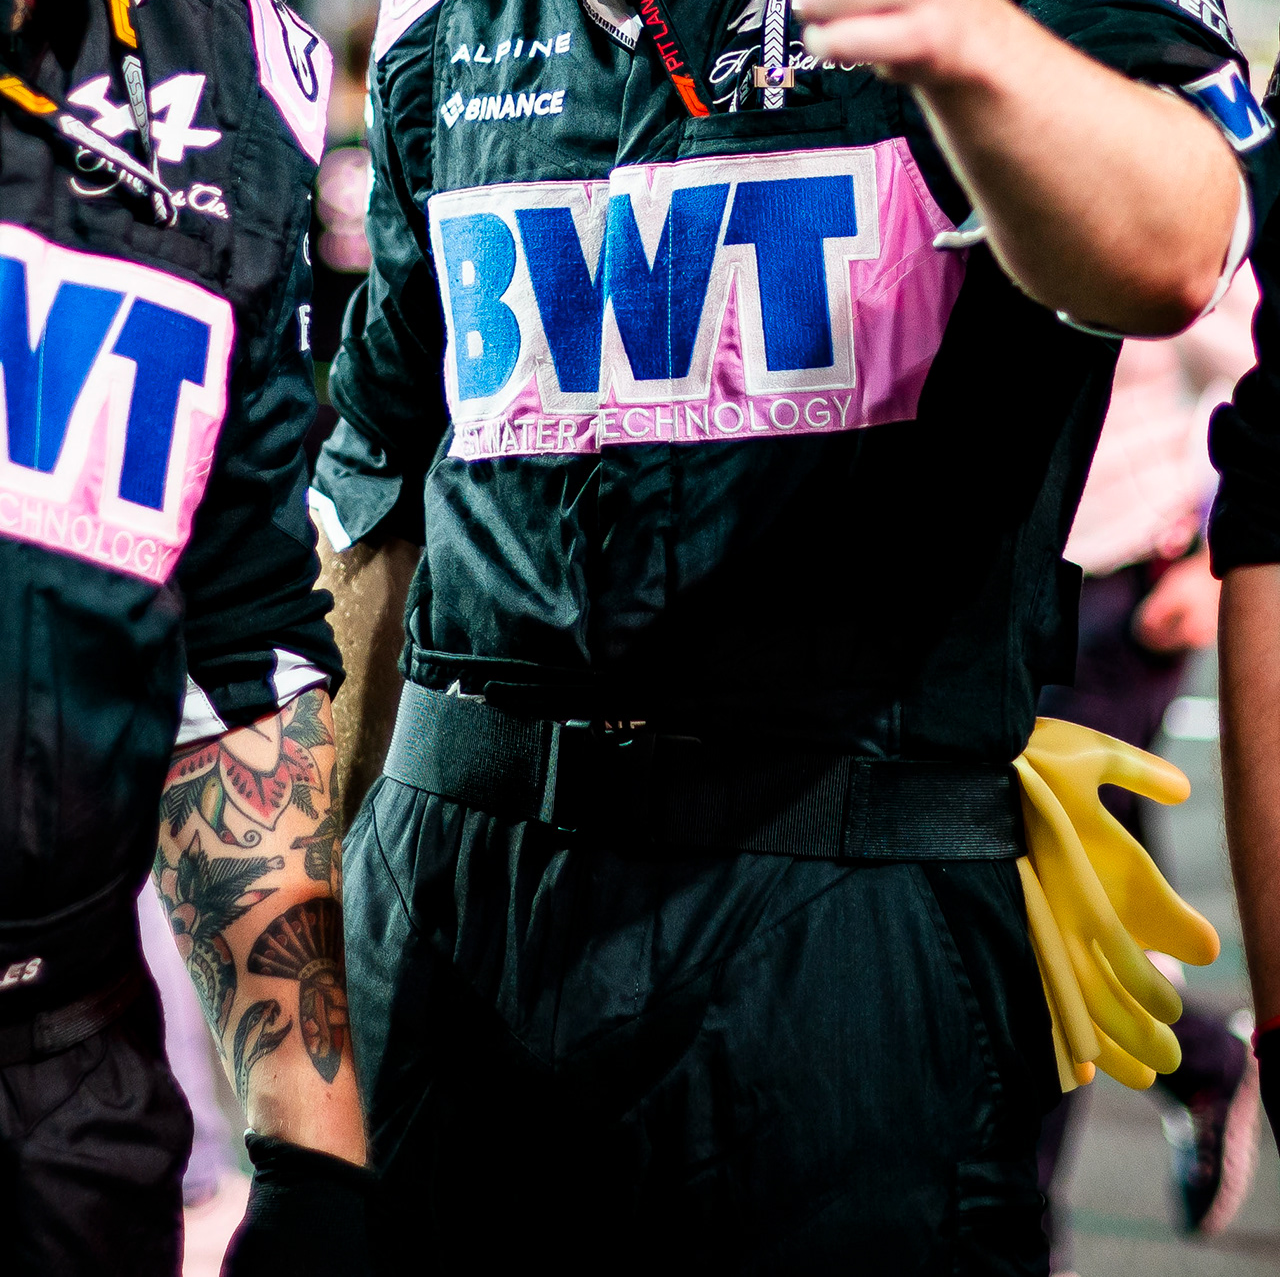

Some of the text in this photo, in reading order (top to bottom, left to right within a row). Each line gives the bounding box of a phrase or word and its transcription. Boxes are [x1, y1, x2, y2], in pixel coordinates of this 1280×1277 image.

[450, 31, 572, 64] ALPINE
[657, 39, 684, 73] PIT
[464, 89, 566, 122] BINANCE
[440, 174, 859, 402] BWT
[483, 418, 578, 454] WATER
[589, 394, 852, 449] TECHNOLOGY
